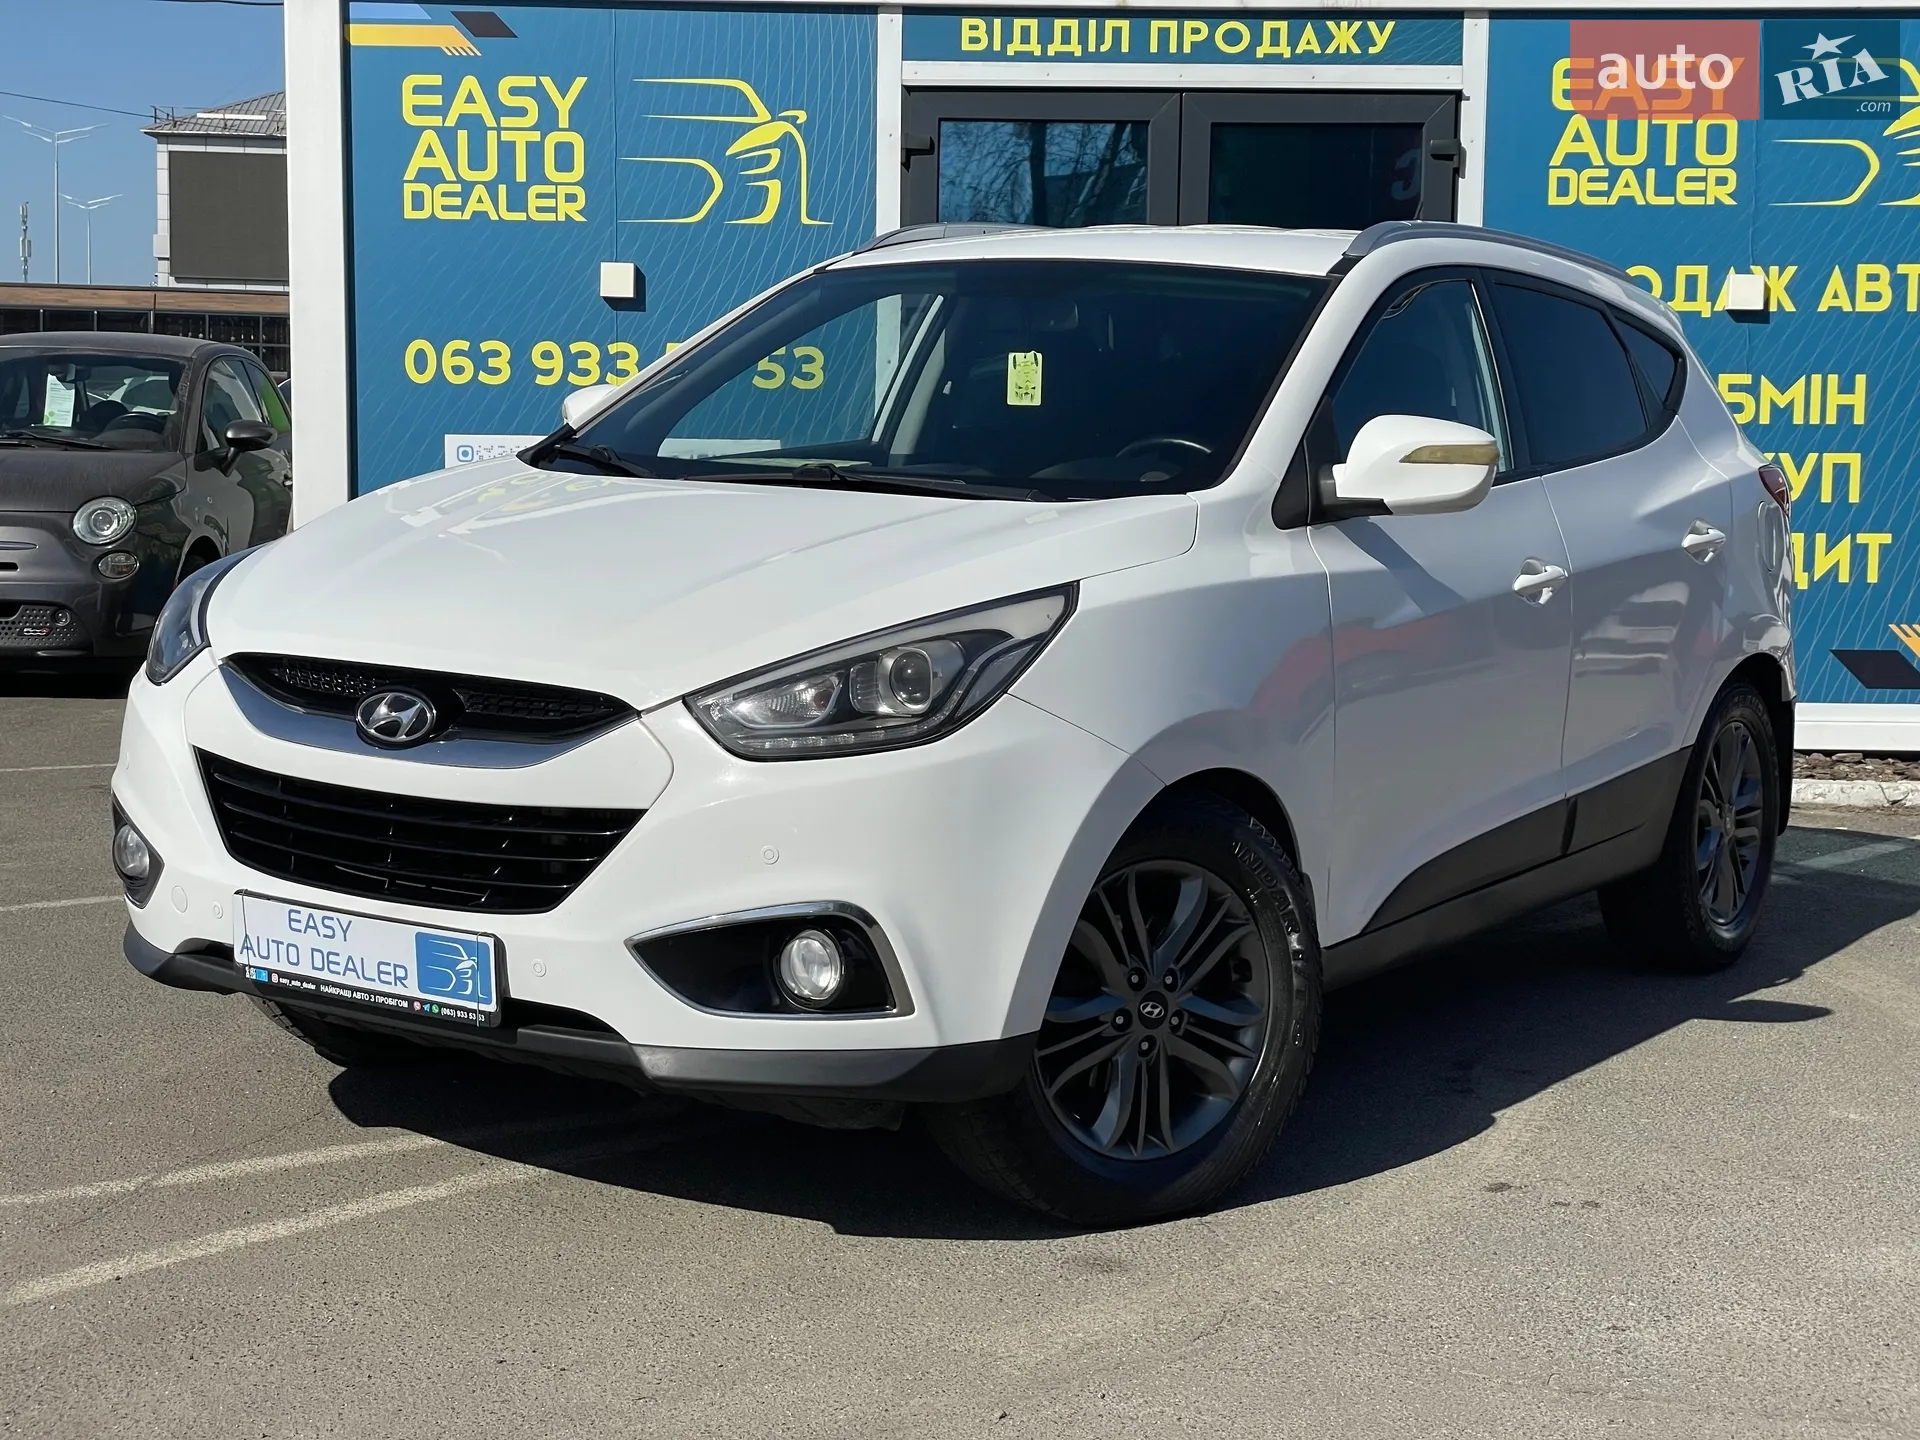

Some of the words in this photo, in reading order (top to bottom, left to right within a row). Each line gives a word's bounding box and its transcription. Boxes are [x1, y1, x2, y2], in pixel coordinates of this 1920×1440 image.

[961, 18, 1130, 56] ВІДДІЛ
[1150, 20, 1395, 58] ПРОДАЖУ
[402, 74, 587, 129] EASY
[403, 130, 585, 183] AUTO
[1549, 112, 1739, 166] AUTO
[403, 182, 587, 222] DEALER
[1548, 168, 1737, 205] DEALER
[404, 339, 511, 385] 063
[531, 341, 639, 387] 933
[752, 346, 825, 389] 53
[1718, 374, 1867, 425] БМІН
[287, 908, 353, 943] EASY
[239, 933, 300, 967] AUTO
[310, 946, 410, 989] DEALER
[320, 984, 352, 998] НАЙКРАЩІ
[352, 991, 370, 1001] АВТО
[375, 996, 409, 1008] ПРОБІГОМ
[456, 1010, 468, 1019] 933
